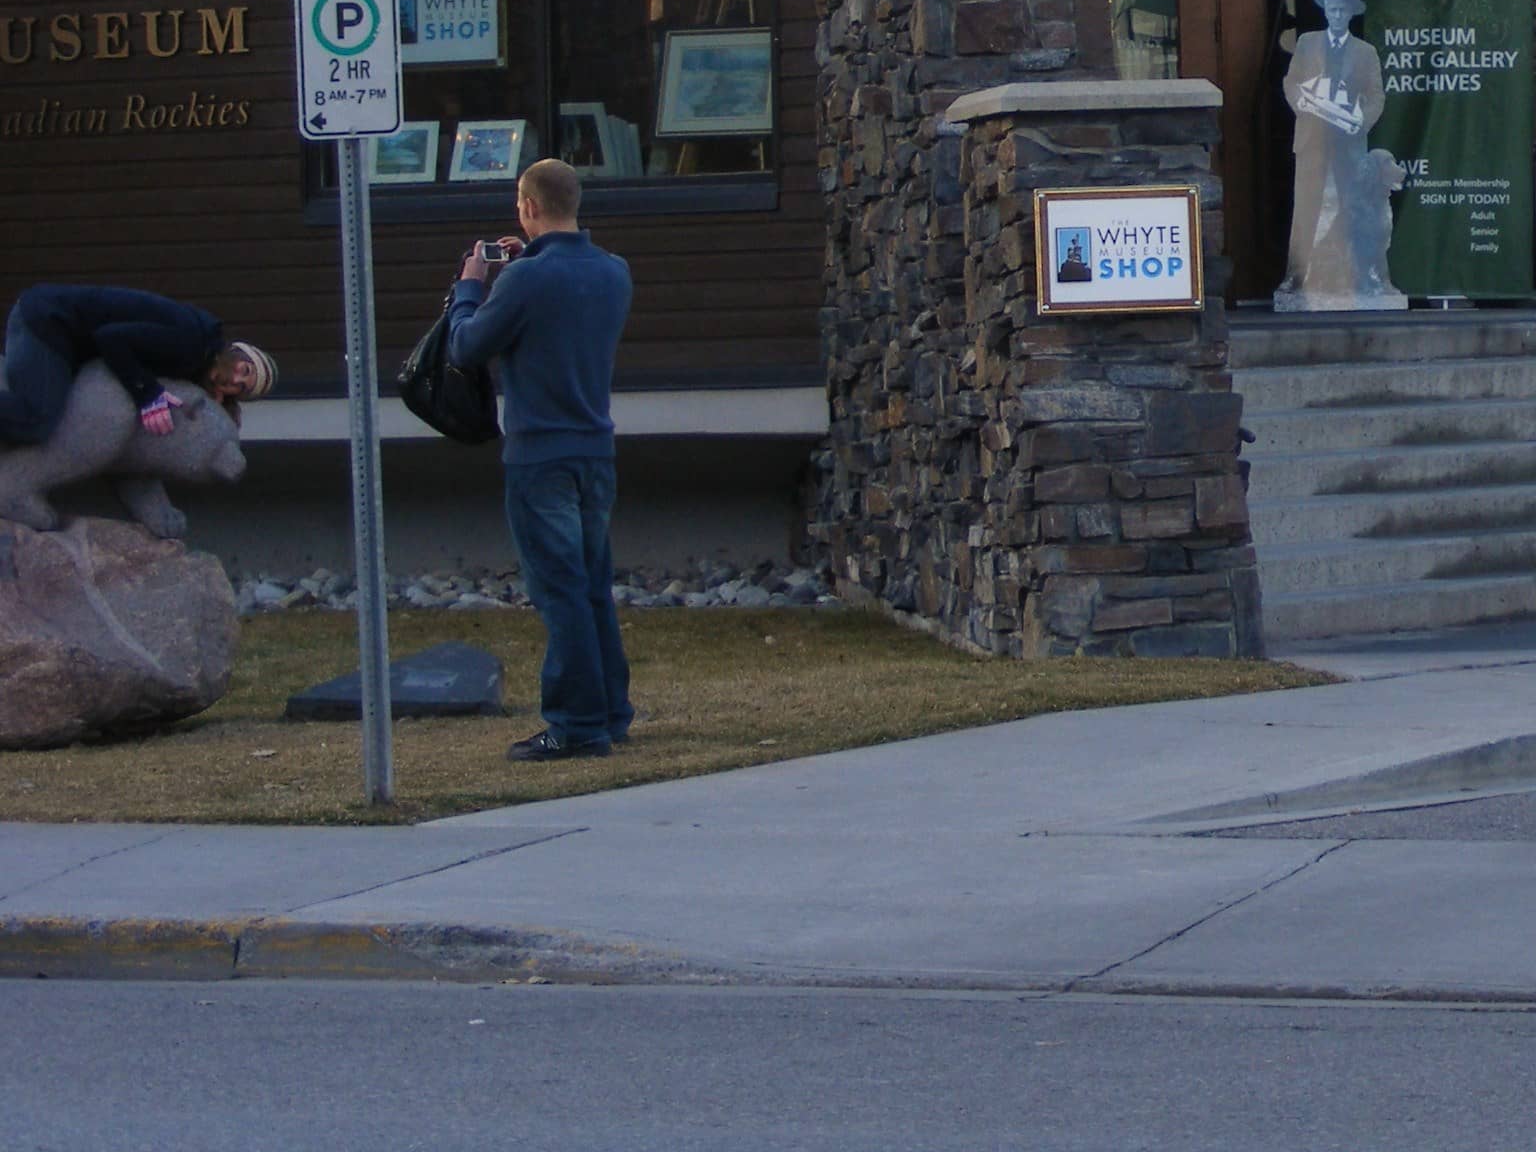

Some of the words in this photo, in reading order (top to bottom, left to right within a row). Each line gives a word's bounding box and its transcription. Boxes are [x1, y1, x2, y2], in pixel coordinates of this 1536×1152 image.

[336, 2, 364, 40] P
[425, 21, 490, 40] SHOP
[1384, 27, 1476, 46] MUSEUM
[1384, 51, 1425, 69] ART
[1430, 50, 1519, 68] GALLERY
[329, 58, 341, 83] 2
[347, 60, 371, 80] HR
[1384, 73, 1482, 93] ARCHIVES
[122, 92, 250, 130] Rockies
[1398, 159, 1429, 176] AVE
[1413, 178, 1451, 188] Museum
[1454, 177, 1511, 190] Membership
[1420, 194, 1447, 205] SIGN
[1450, 194, 1465, 205] UP
[1467, 193, 1511, 205] TODAY!
[1470, 211, 1496, 221] Adult
[1097, 226, 1181, 245] WHYTE
[1470, 227, 1499, 237] Senior
[1098, 246, 1182, 257] MUSEUM
[1470, 242, 1500, 254] Family
[1099, 257, 1184, 280] SHOP
